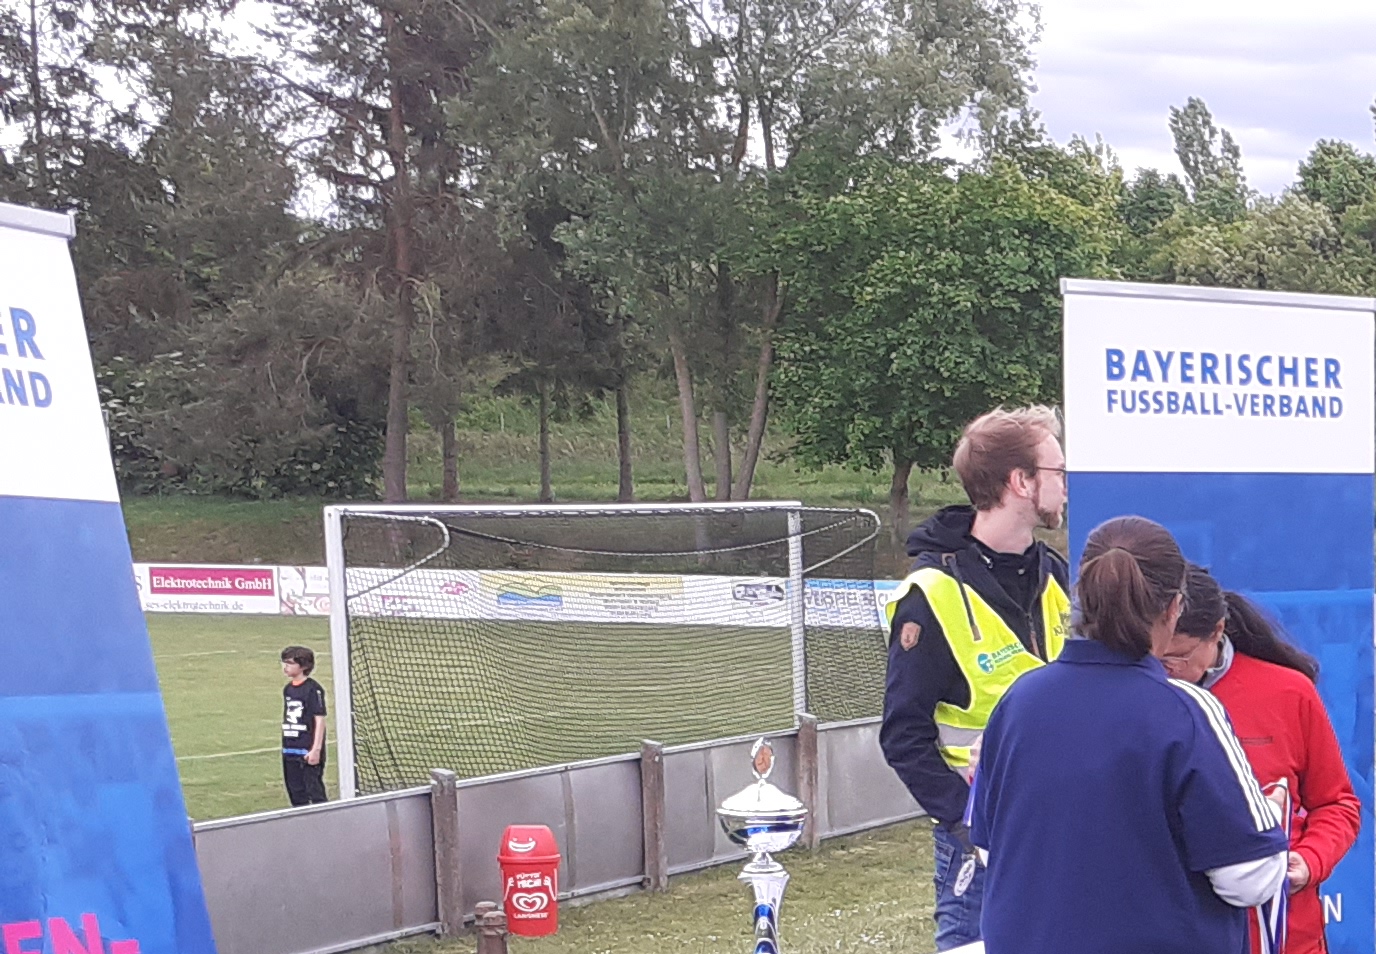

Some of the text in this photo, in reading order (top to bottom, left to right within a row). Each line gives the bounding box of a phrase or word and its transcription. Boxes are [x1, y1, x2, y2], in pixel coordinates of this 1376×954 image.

[0, 306, 46, 361] R
[0, 367, 53, 408] ND
[1105, 348, 1343, 389] BAYERISCHER
[1106, 389, 1344, 418] FUSSBALL-VERBAND
[152, 576, 272, 591] Elektrotechnik GmbH
